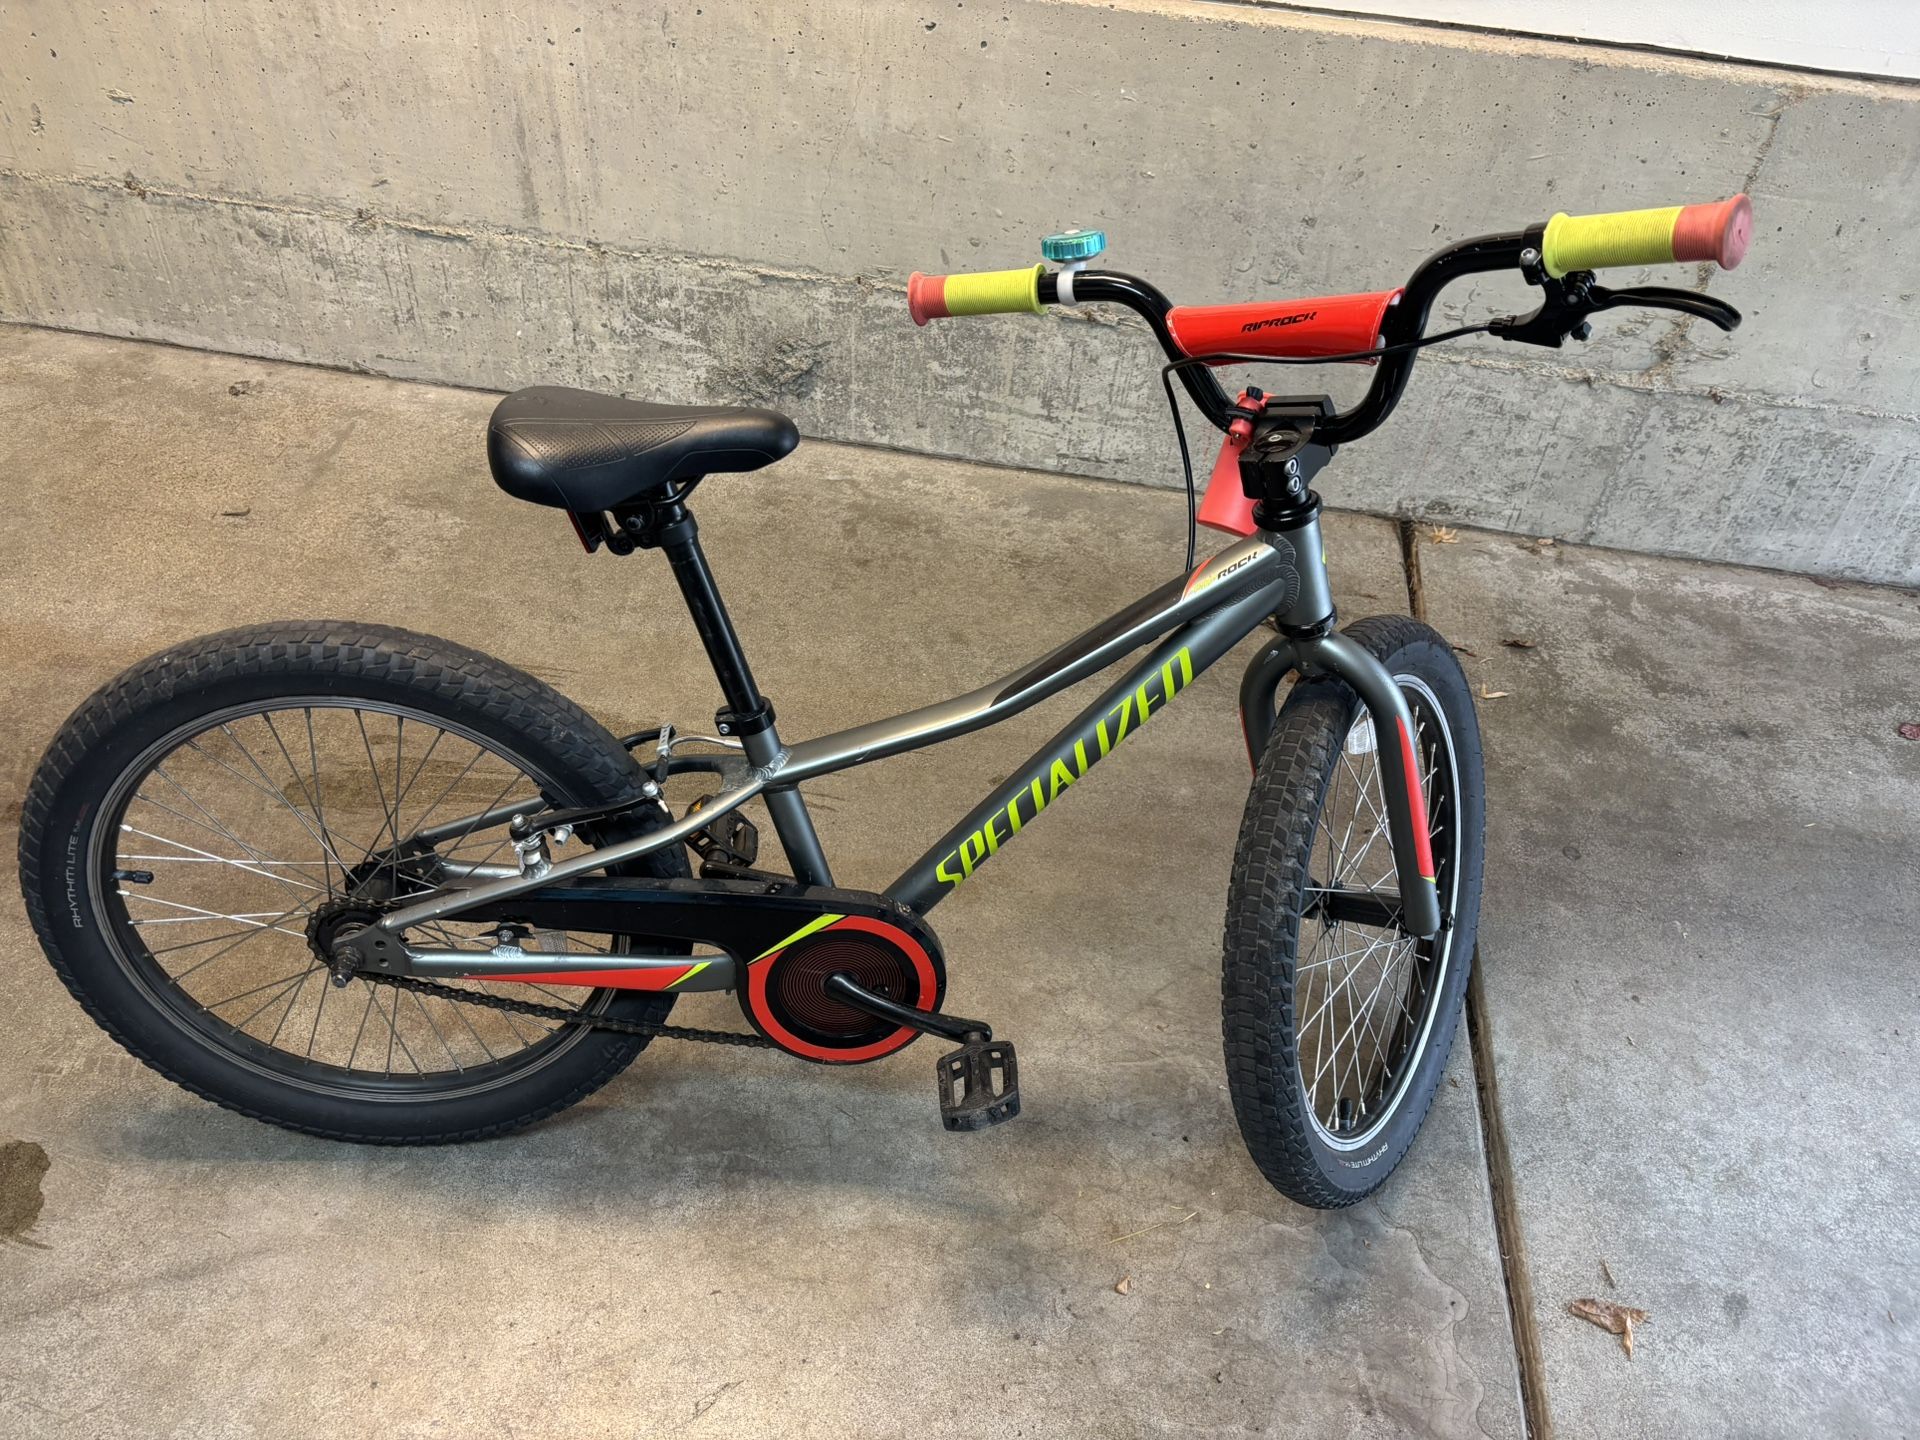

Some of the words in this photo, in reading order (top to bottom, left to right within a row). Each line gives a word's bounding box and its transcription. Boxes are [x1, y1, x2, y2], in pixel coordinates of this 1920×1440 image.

[1241, 312, 1317, 333] RIPROCK
[935, 646, 1193, 888] SPECIALIZED
[66, 835, 79, 864] LITE
